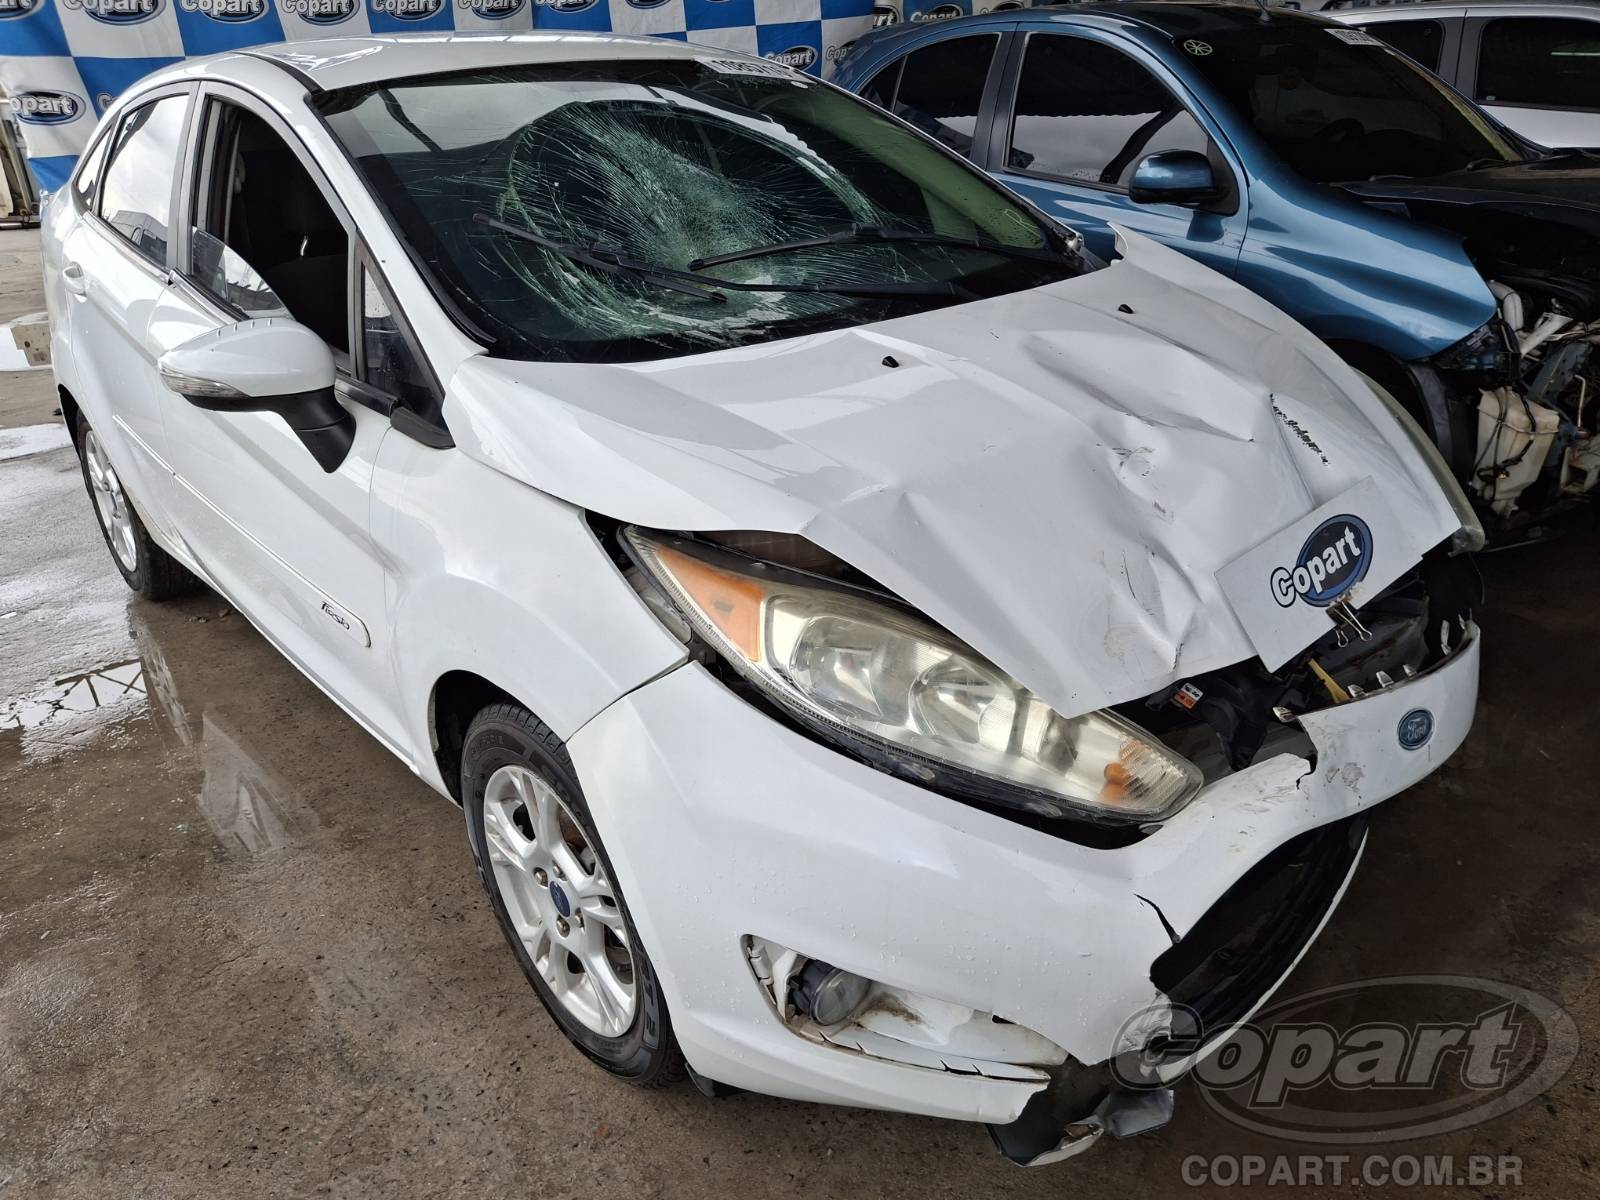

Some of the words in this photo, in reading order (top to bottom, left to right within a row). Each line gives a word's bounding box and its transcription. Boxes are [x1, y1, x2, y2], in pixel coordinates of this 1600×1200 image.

[281, 0, 350, 17] Copart
[372, 0, 438, 15] Copart
[9, 96, 74, 117] opart
[1270, 525, 1361, 608] Copart
